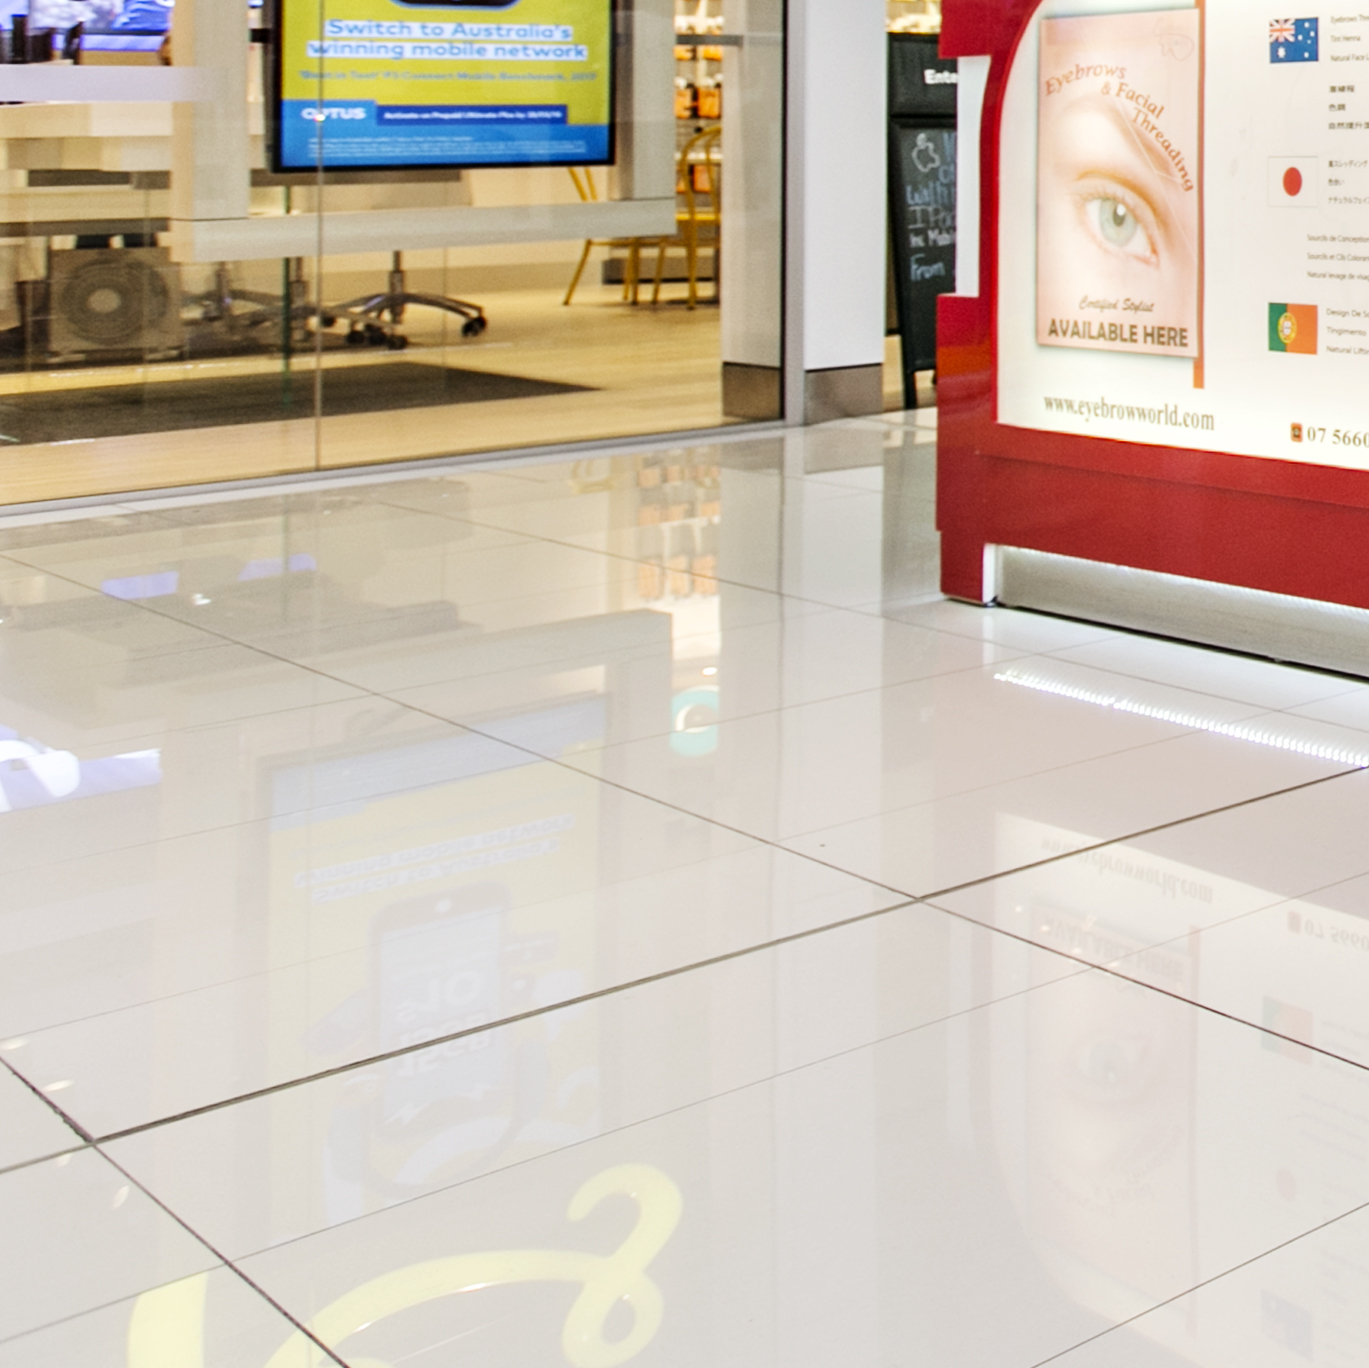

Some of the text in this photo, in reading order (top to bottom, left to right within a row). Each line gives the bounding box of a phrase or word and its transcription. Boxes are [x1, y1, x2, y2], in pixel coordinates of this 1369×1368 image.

[329, 19, 572, 39] Switch to Australia's
[309, 41, 586, 60] winning mobile network
[1045, 64, 1127, 96] Eyebrows
[1101, 81, 1165, 119] & Facial
[1132, 107, 1194, 192] Threading
[1326, 308, 1349, 318] Design
[1352, 309, 1361, 317] De
[1048, 318, 1188, 347] AVAILABLE HERE
[1326, 326, 1366, 336] Tingimento
[1326, 345, 1351, 354] Natural
[1044, 396, 1215, 431] www.eyebrowworld.com
[1307, 427, 1326, 442] 07
